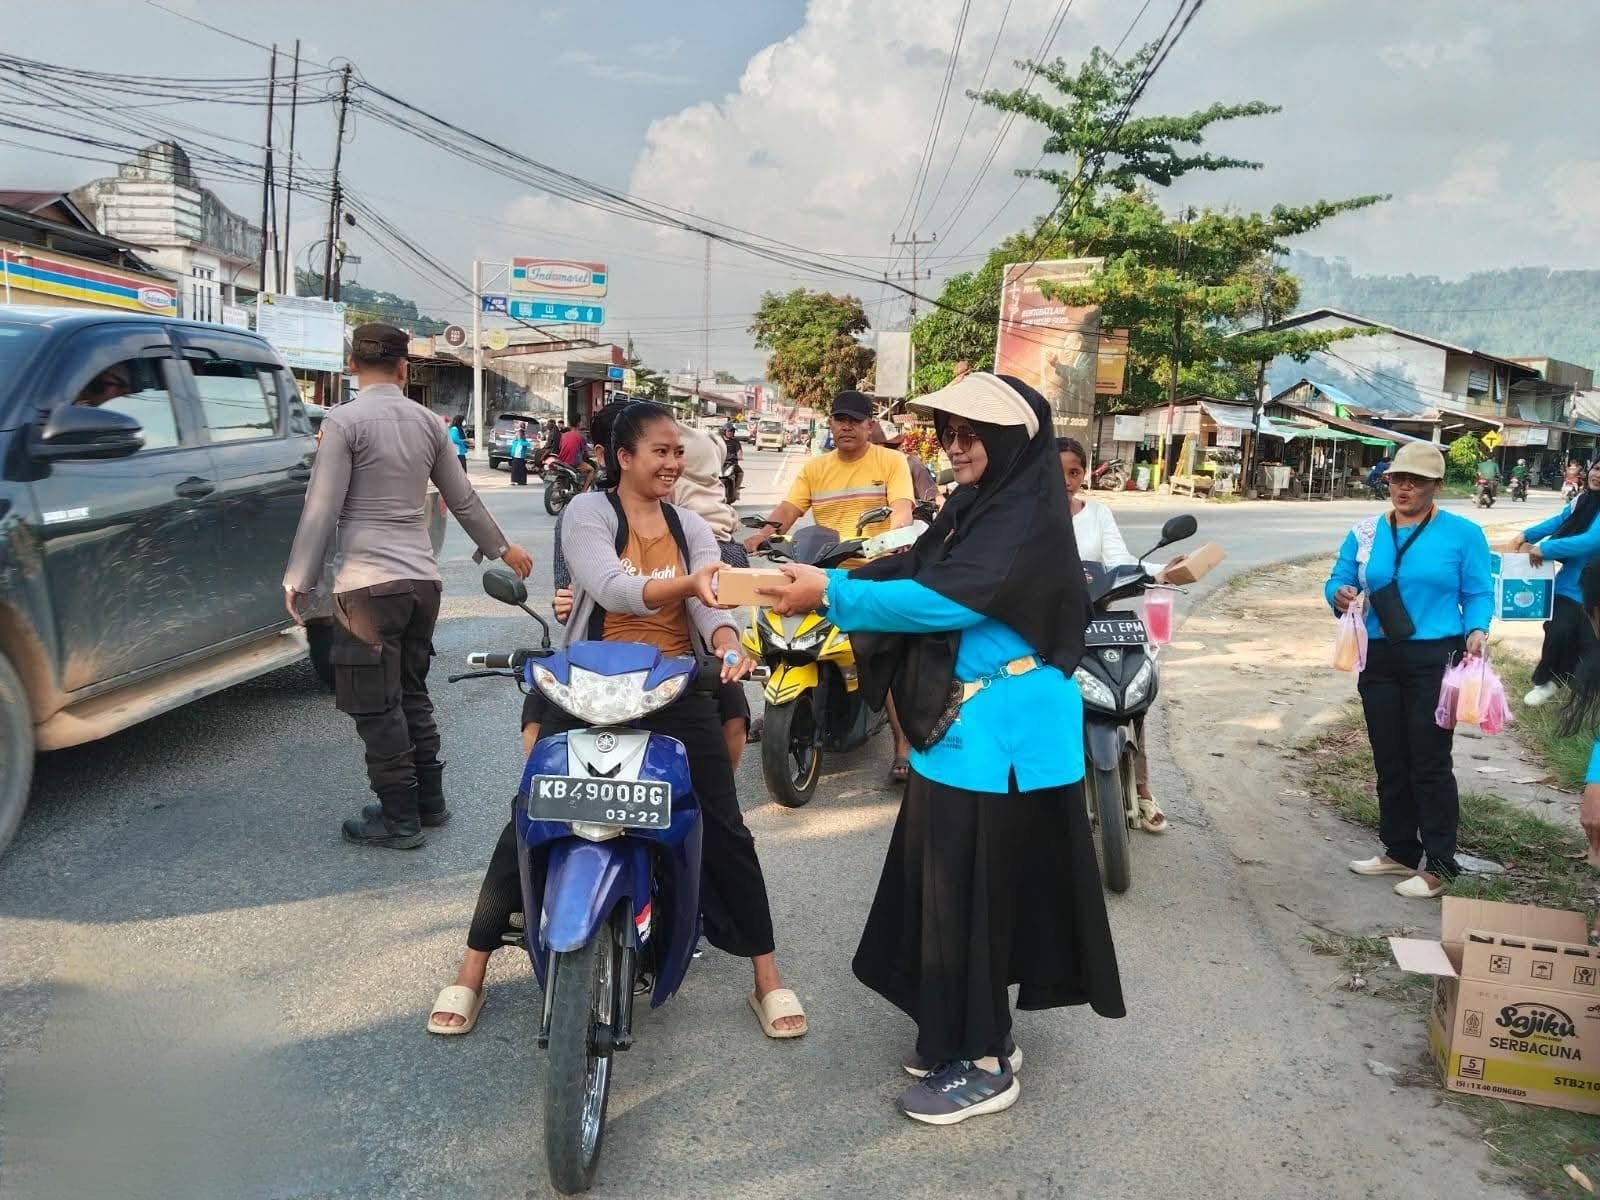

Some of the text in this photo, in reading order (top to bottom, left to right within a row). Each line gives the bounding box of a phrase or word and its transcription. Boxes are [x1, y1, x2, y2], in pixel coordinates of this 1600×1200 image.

[1118, 622, 1144, 633] EPM
[1495, 1006, 1576, 1039] Sajiku
[1489, 1036, 1582, 1061] SERBAGUNA
[1468, 1058, 1477, 1069] 5
